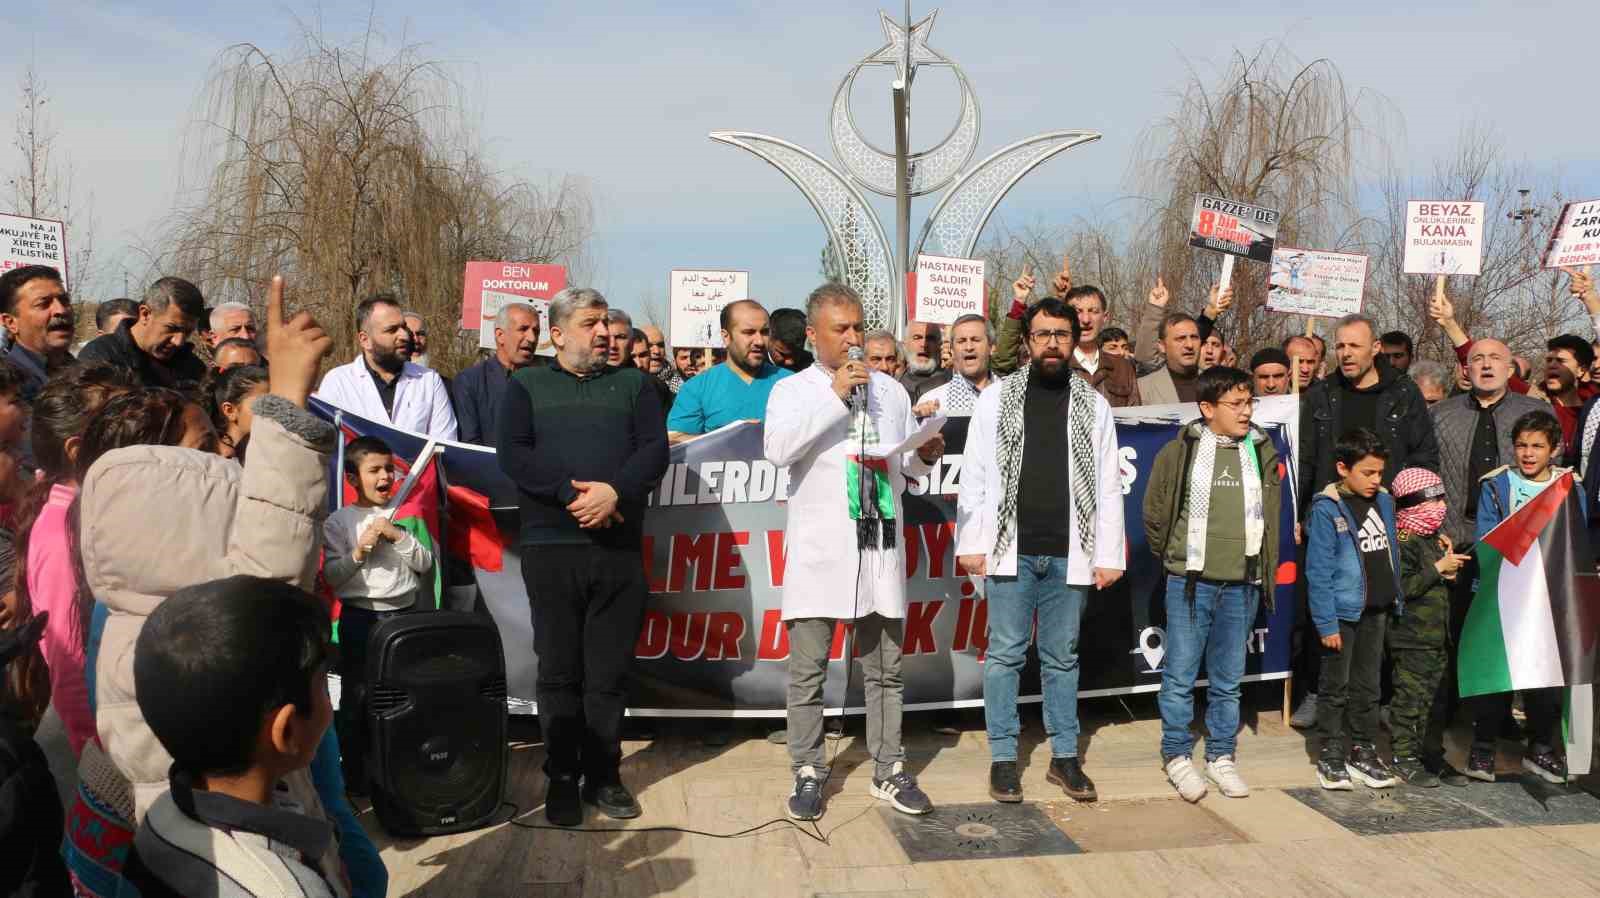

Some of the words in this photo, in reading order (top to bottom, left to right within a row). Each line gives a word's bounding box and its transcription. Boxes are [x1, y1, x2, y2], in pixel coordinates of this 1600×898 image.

[1419, 204, 1472, 216] BEYAZ
[30, 223, 45, 231] NA
[1199, 210, 1215, 236] 8
[1572, 216, 1600, 227] ZAR
[1421, 225, 1466, 237] KANA
[43, 233, 57, 242] RA
[502, 265, 530, 278] BEN
[919, 261, 982, 274] HASTANEYE
[482, 279, 549, 291] DOKTORUM
[929, 273, 971, 285] SALDIRI
